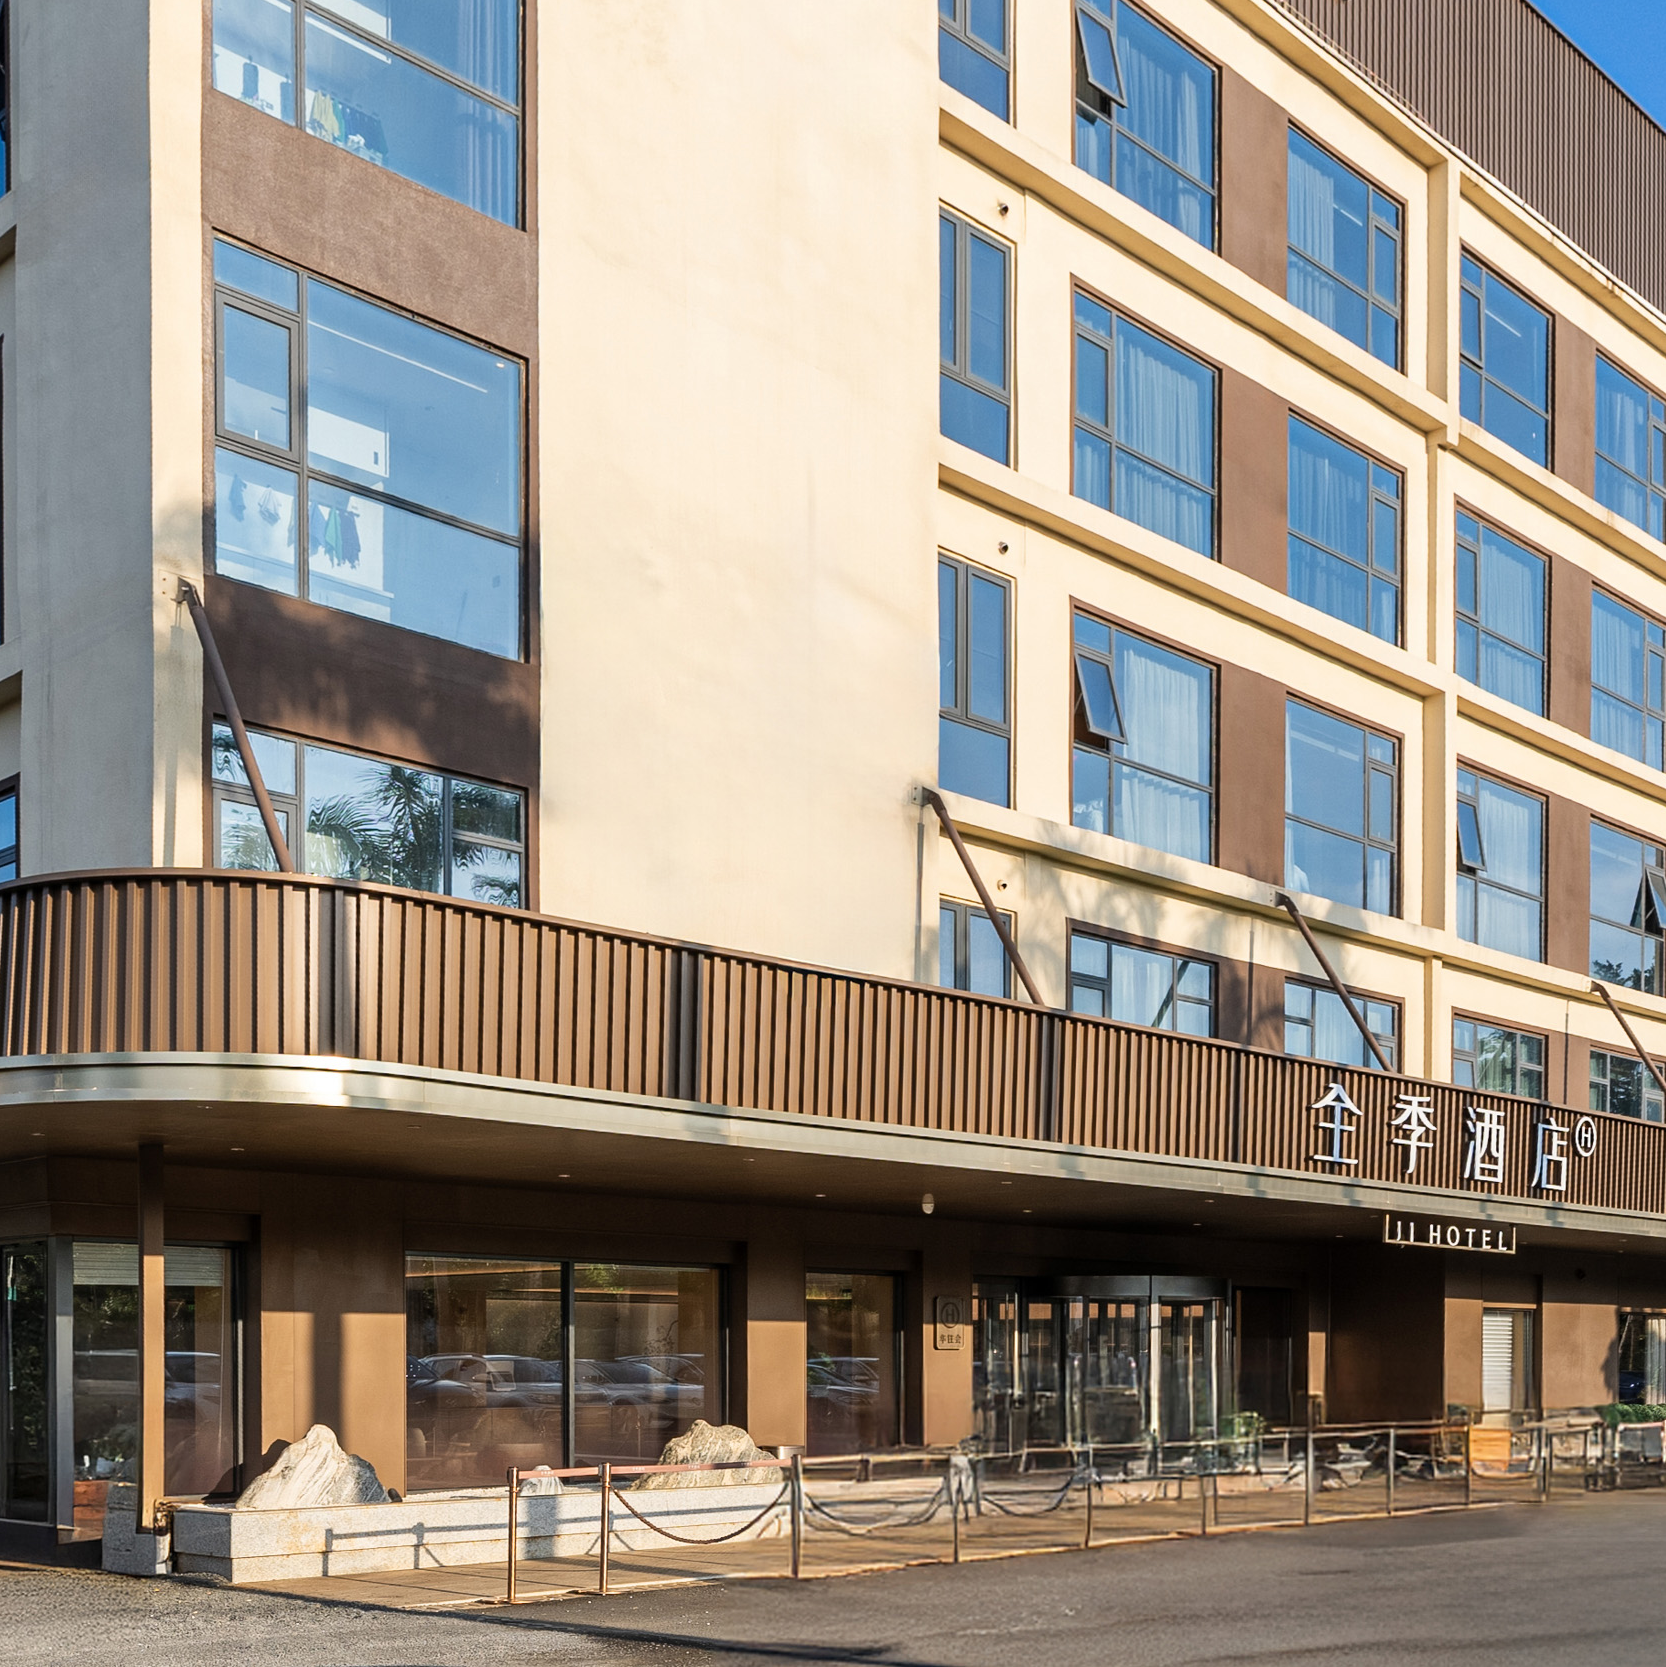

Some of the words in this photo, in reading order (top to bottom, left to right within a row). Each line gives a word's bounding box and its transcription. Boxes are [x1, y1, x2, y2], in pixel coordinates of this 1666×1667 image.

[1311, 1083, 1569, 1191] 全季酒店
[1396, 1220, 1414, 1242] JI
[1429, 1223, 1507, 1251] HOTEL
